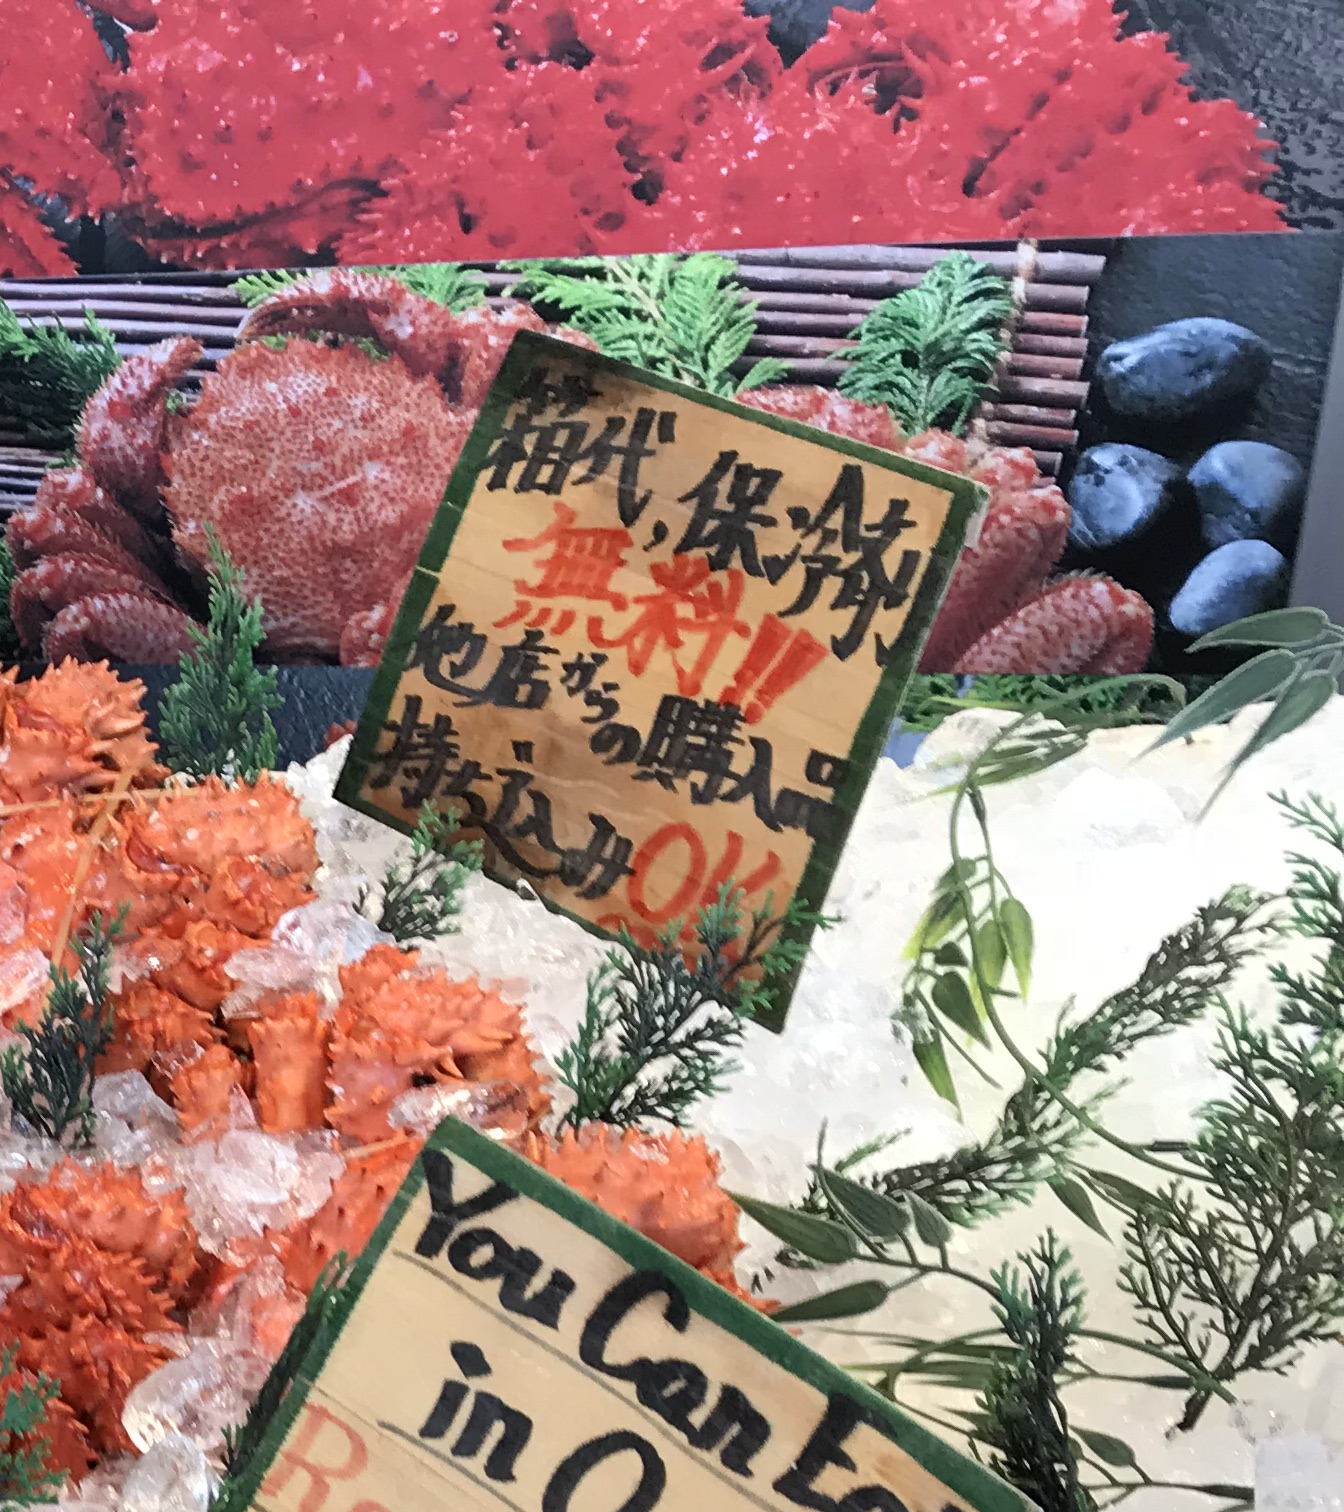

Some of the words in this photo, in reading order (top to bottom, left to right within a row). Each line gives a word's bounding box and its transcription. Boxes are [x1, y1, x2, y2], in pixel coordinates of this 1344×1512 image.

[411, 1149, 576, 1331] You
[578, 1269, 774, 1479] Can
[417, 1341, 535, 1484] in
